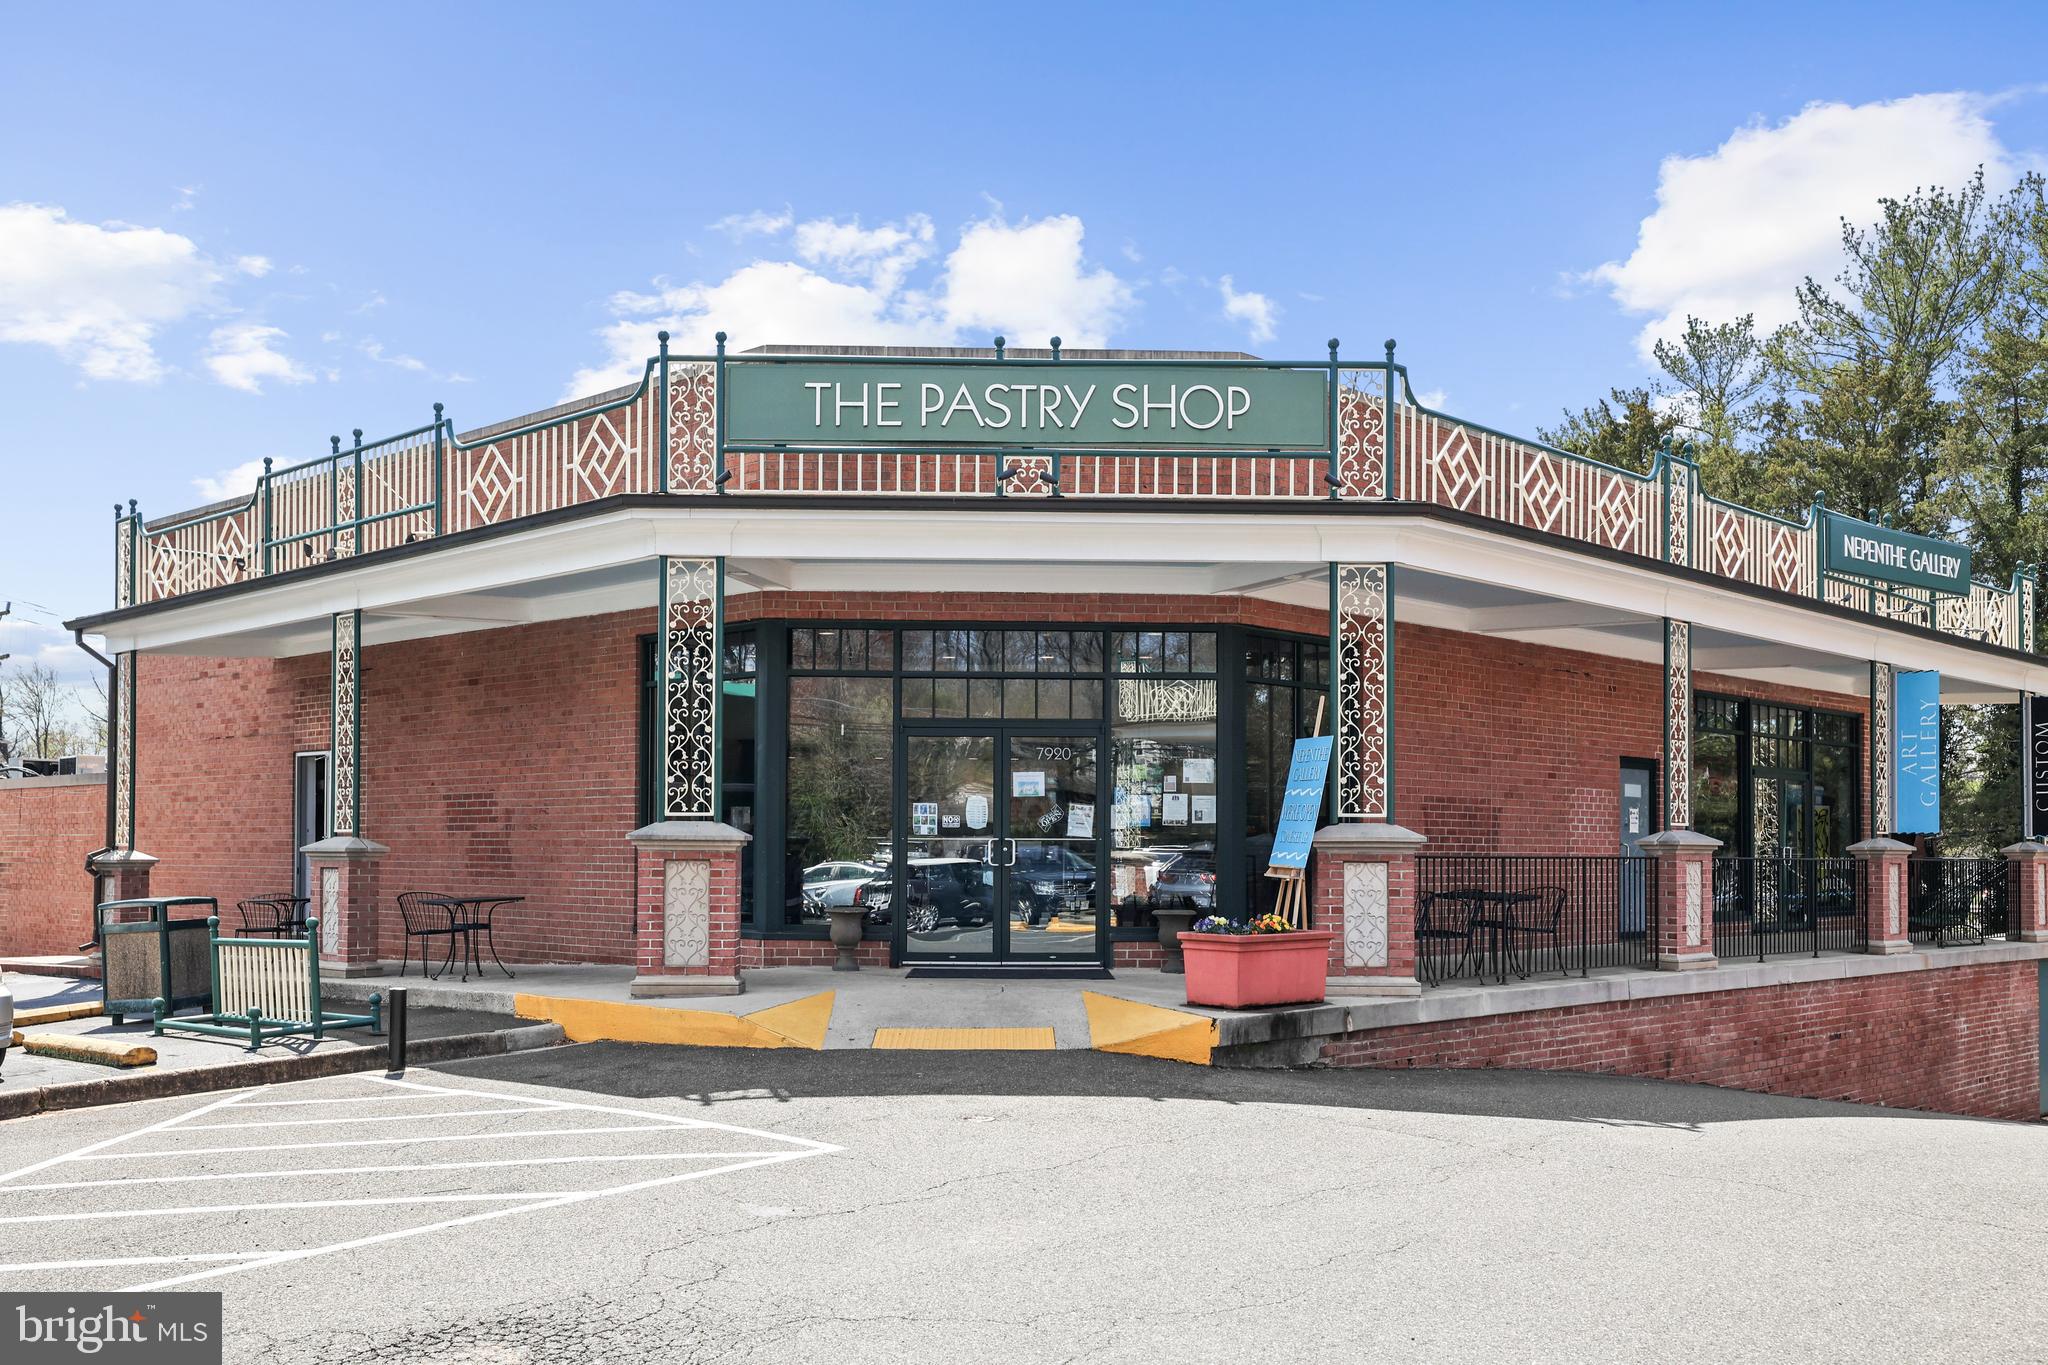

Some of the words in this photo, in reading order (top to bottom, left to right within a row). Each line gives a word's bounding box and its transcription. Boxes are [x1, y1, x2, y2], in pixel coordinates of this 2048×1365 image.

[804, 382, 902, 427] THE
[920, 382, 1096, 429] PASTRY
[1111, 383, 1251, 430] SHOP
[1844, 534, 1908, 569] NEPENTHE
[1909, 549, 1961, 579] GALLERY
[1036, 747, 1072, 761] 7920
[1901, 730, 1918, 776] ART
[1919, 699, 1937, 807] GALLERY
[2034, 722, 2048, 812] CUSTOM
[1041, 810, 1062, 827] OPEN
